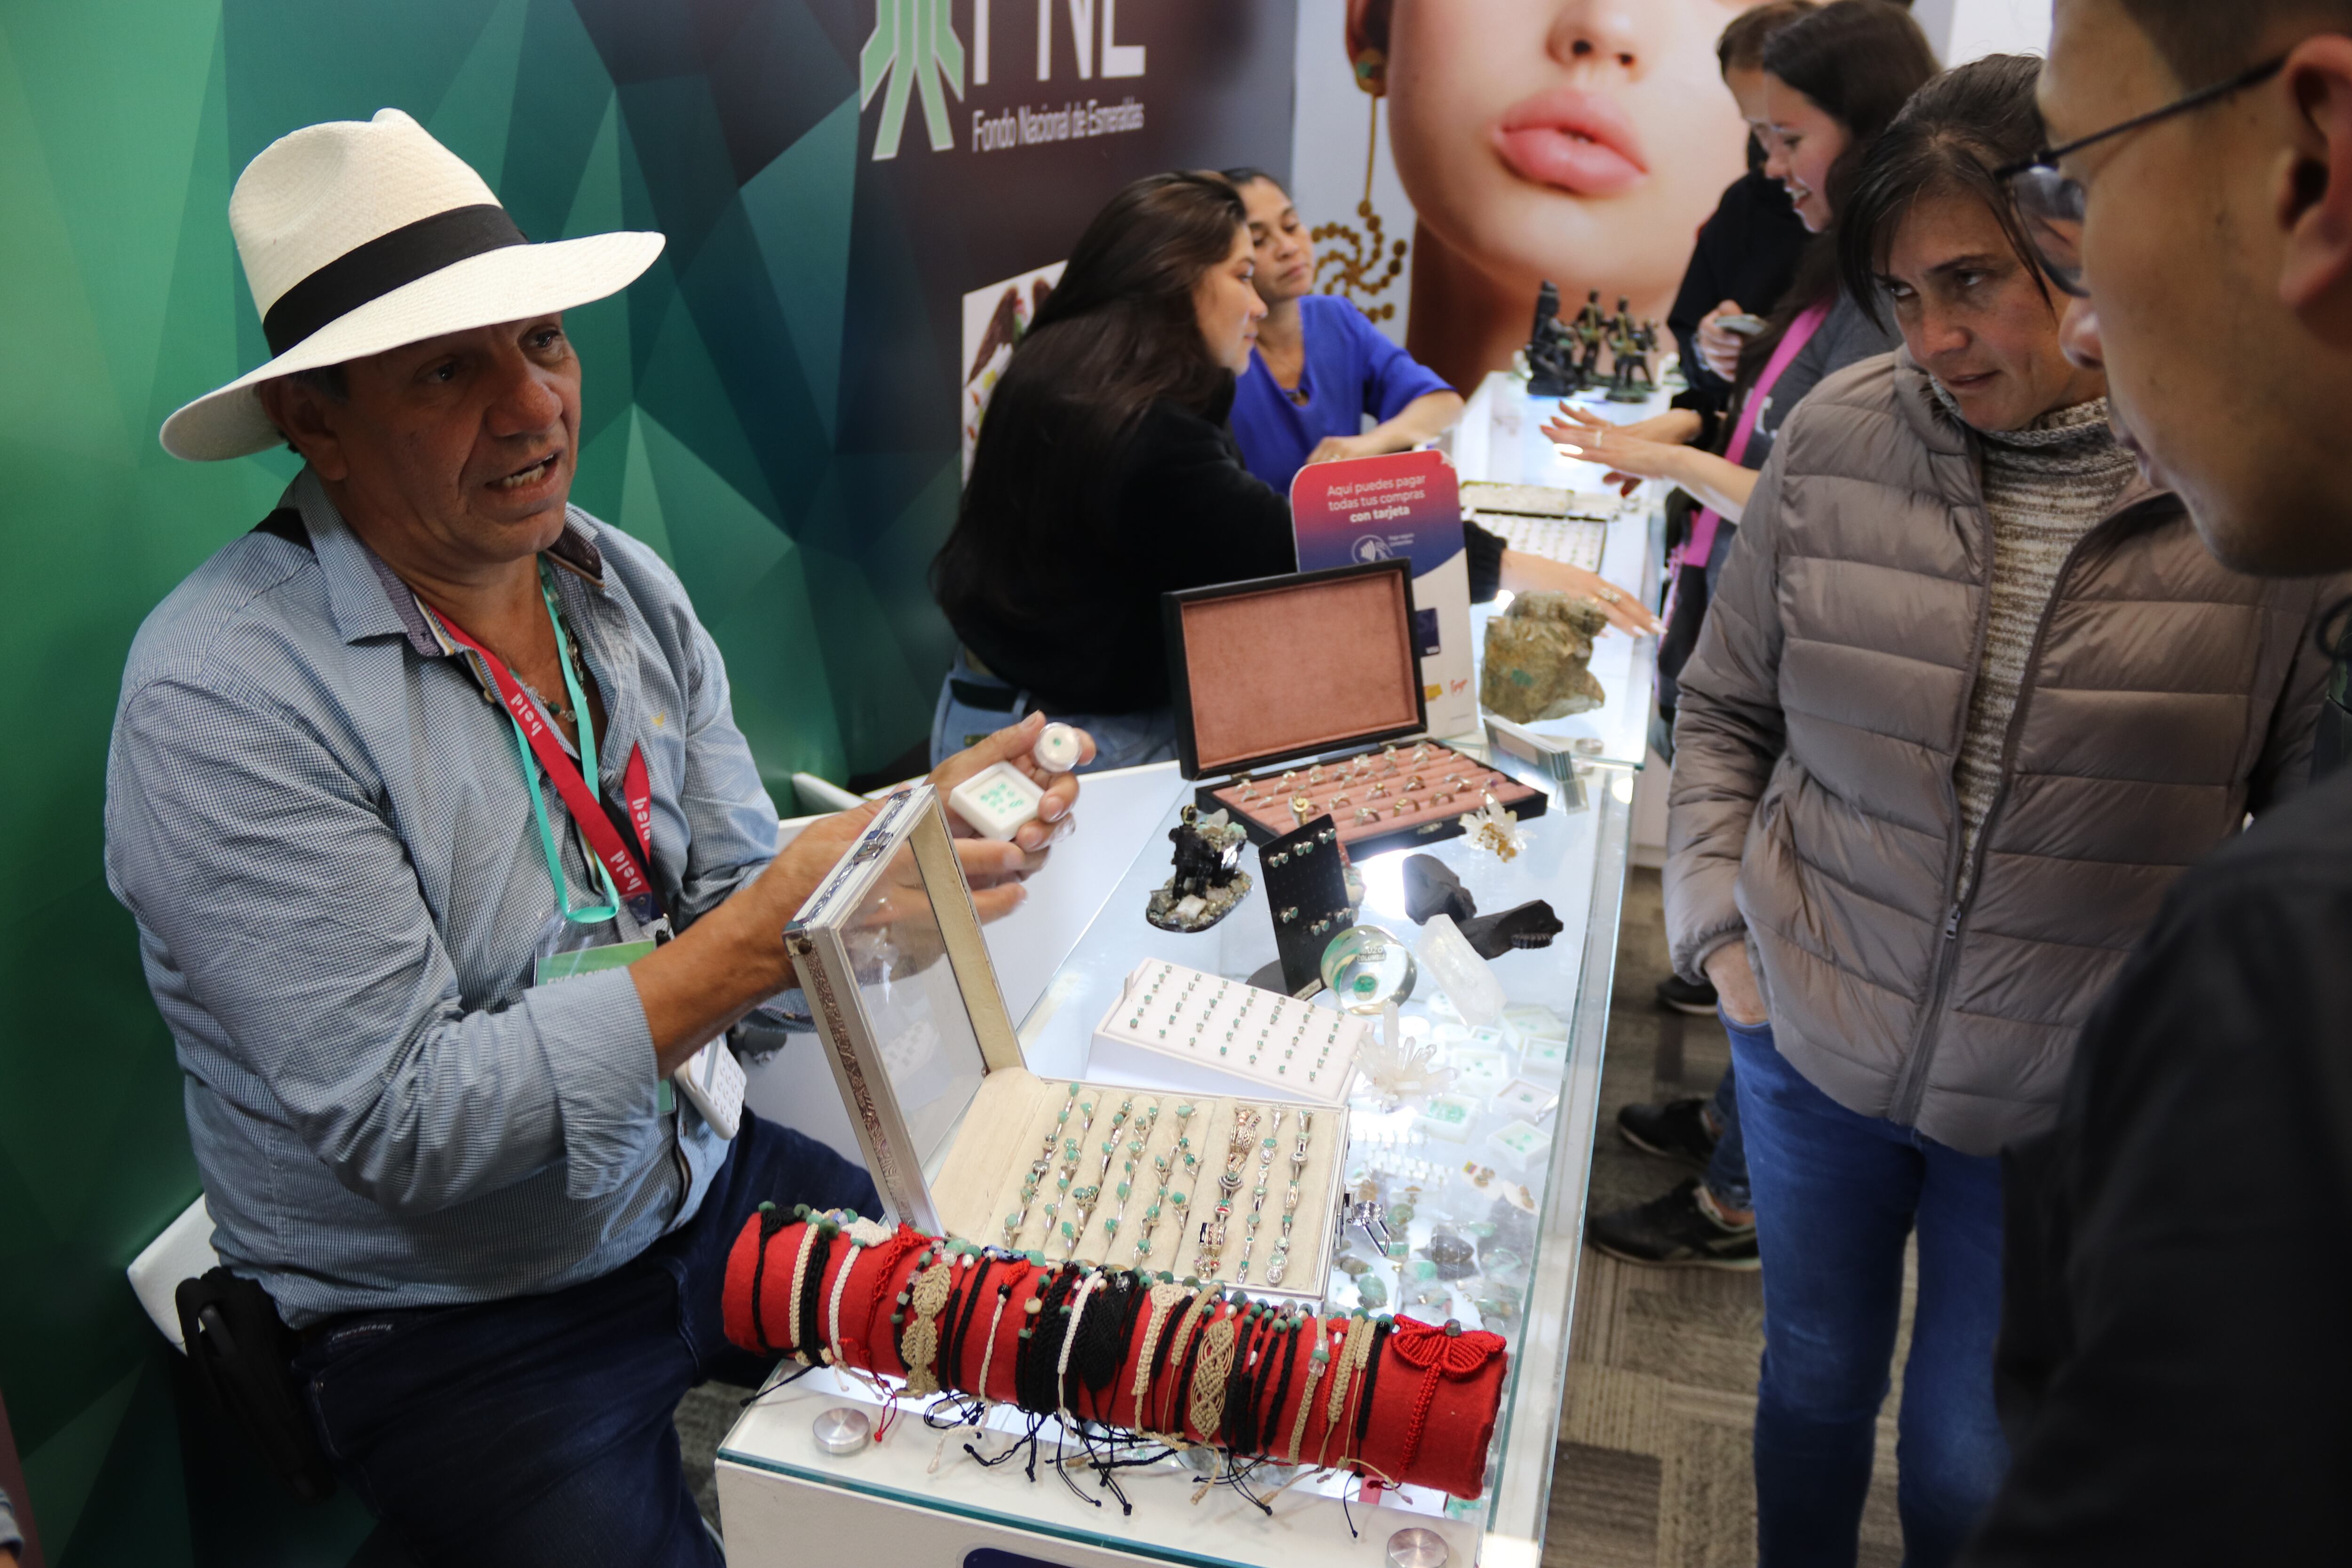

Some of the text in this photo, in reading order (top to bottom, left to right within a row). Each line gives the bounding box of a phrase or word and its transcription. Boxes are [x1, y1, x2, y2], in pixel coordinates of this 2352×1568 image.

[972, 106, 1017, 153] Fondo
[1018, 101, 1072, 145] Nacional
[1072, 101, 1085, 138] de
[1355, 479, 1394, 494] puedes
[1396, 475, 1426, 489] pagar
[1328, 490, 1425, 511] todas tus compras
[1350, 506, 1410, 523] con tarjeta
[511, 692, 542, 737] bold
[611, 850, 641, 891] bold
